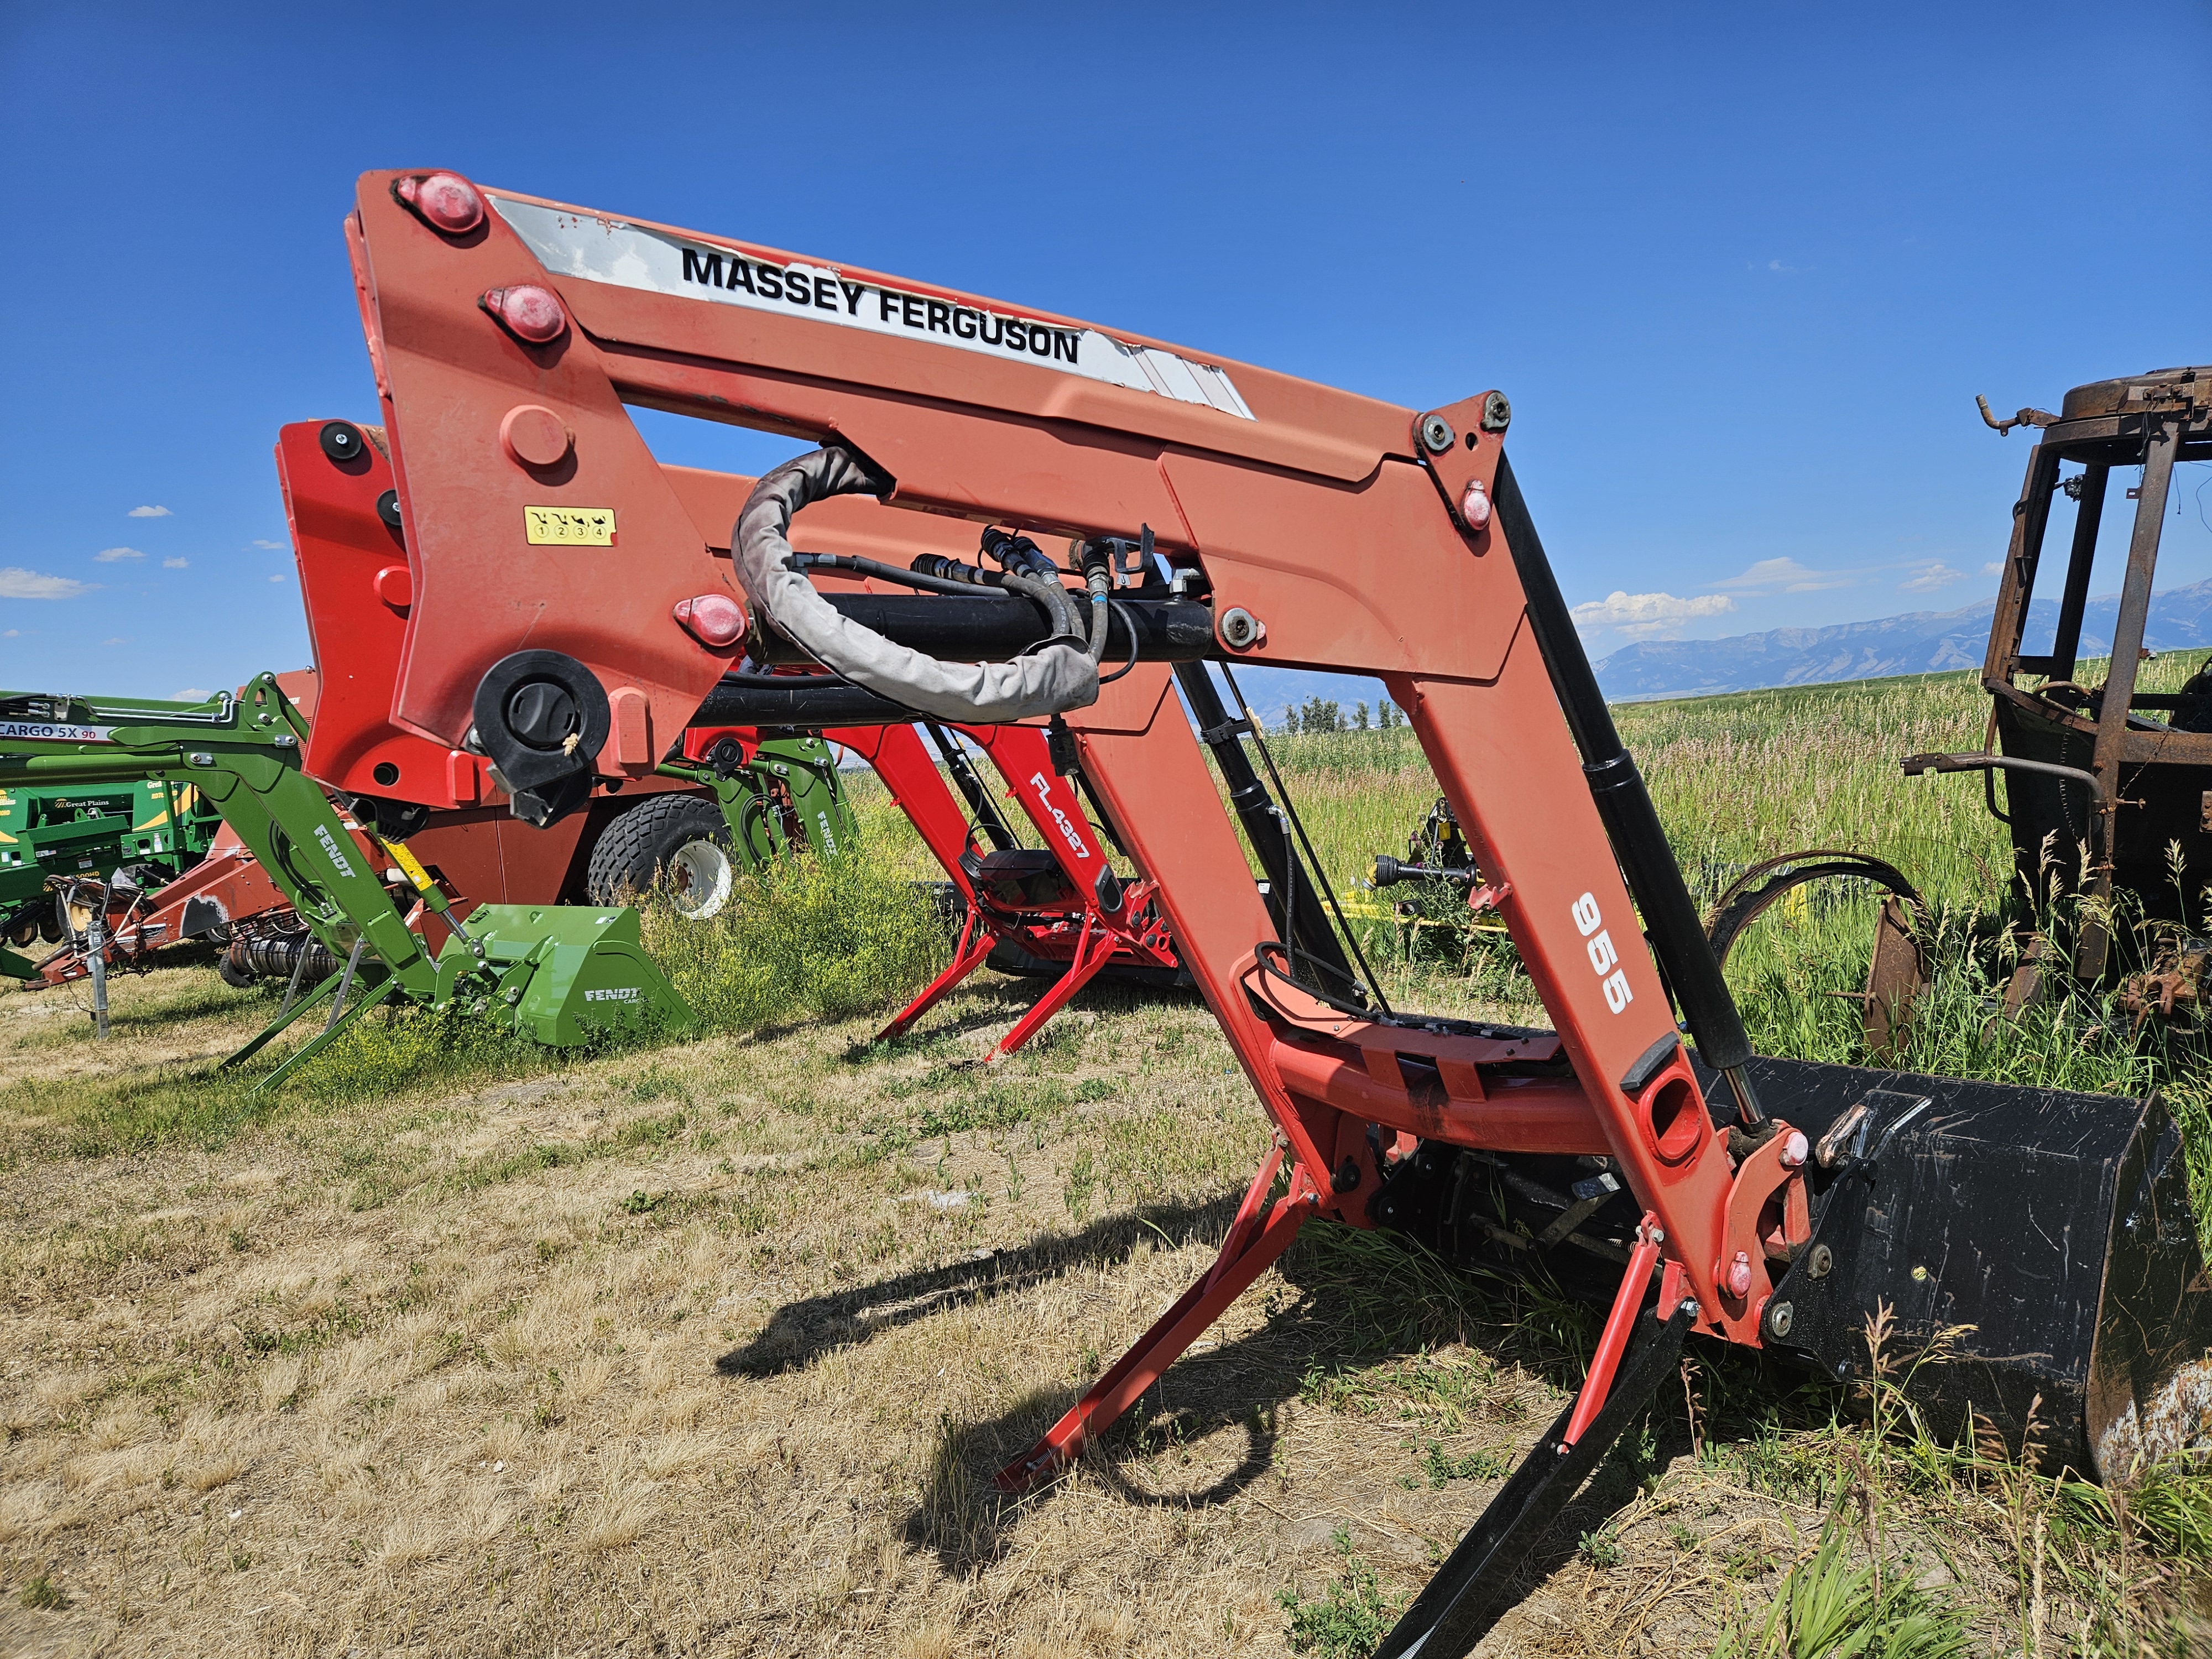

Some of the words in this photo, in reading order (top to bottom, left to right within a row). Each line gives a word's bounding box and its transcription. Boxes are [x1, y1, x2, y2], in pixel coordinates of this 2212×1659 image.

[682, 247, 867, 315] MASSEY
[879, 290, 1078, 364] FERGUSON
[58, 728, 77, 738] 5X
[81, 731, 96, 739] 90
[313, 823, 356, 878] FENDT
[1571, 891, 1634, 1015] 955
[585, 987, 642, 1001] FENDT
